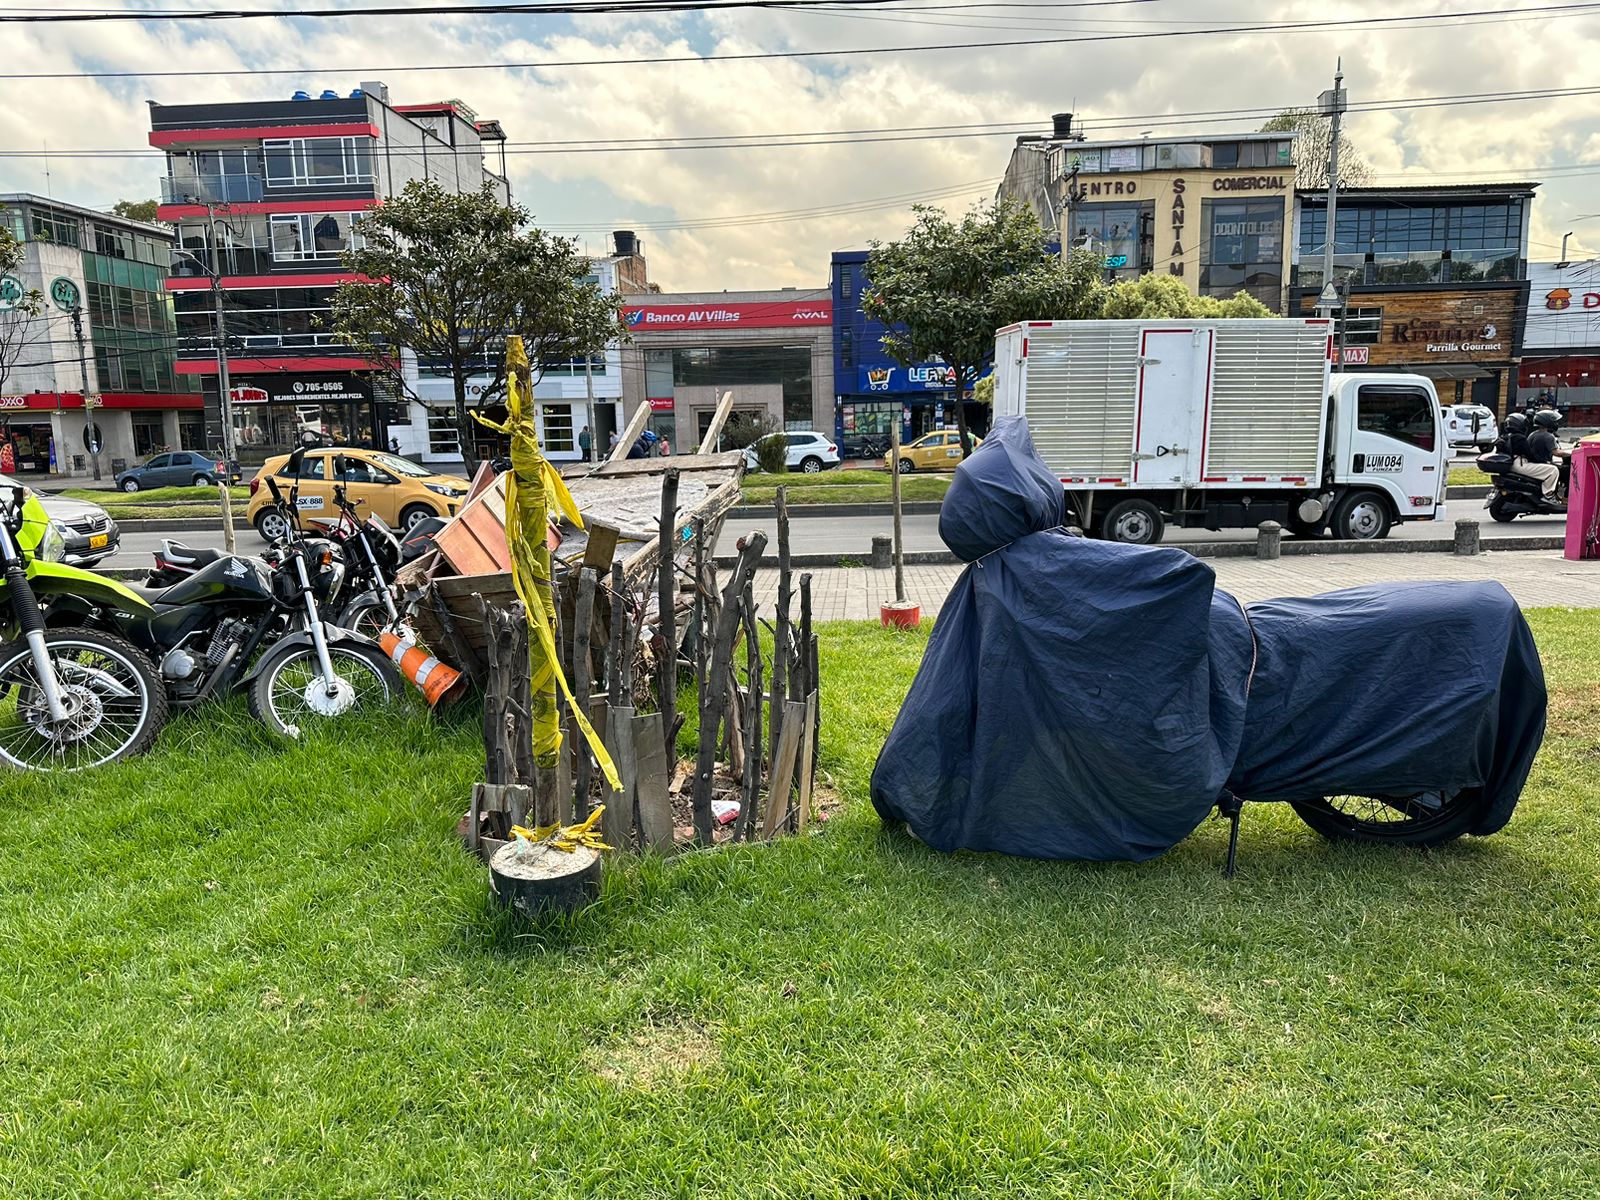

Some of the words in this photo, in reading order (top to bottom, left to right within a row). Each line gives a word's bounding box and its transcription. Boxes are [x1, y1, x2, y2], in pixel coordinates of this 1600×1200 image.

[1213, 176, 1287, 192] COMERCIAL
[645, 312, 686, 323] Banco
[687, 311, 706, 322] AV
[705, 310, 741, 322] Villas
[792, 311, 829, 320] AVAL
[1426, 342, 1459, 352] Parrilla
[1461, 341, 1502, 351] Gourmet
[304, 381, 344, 392] 705-0505
